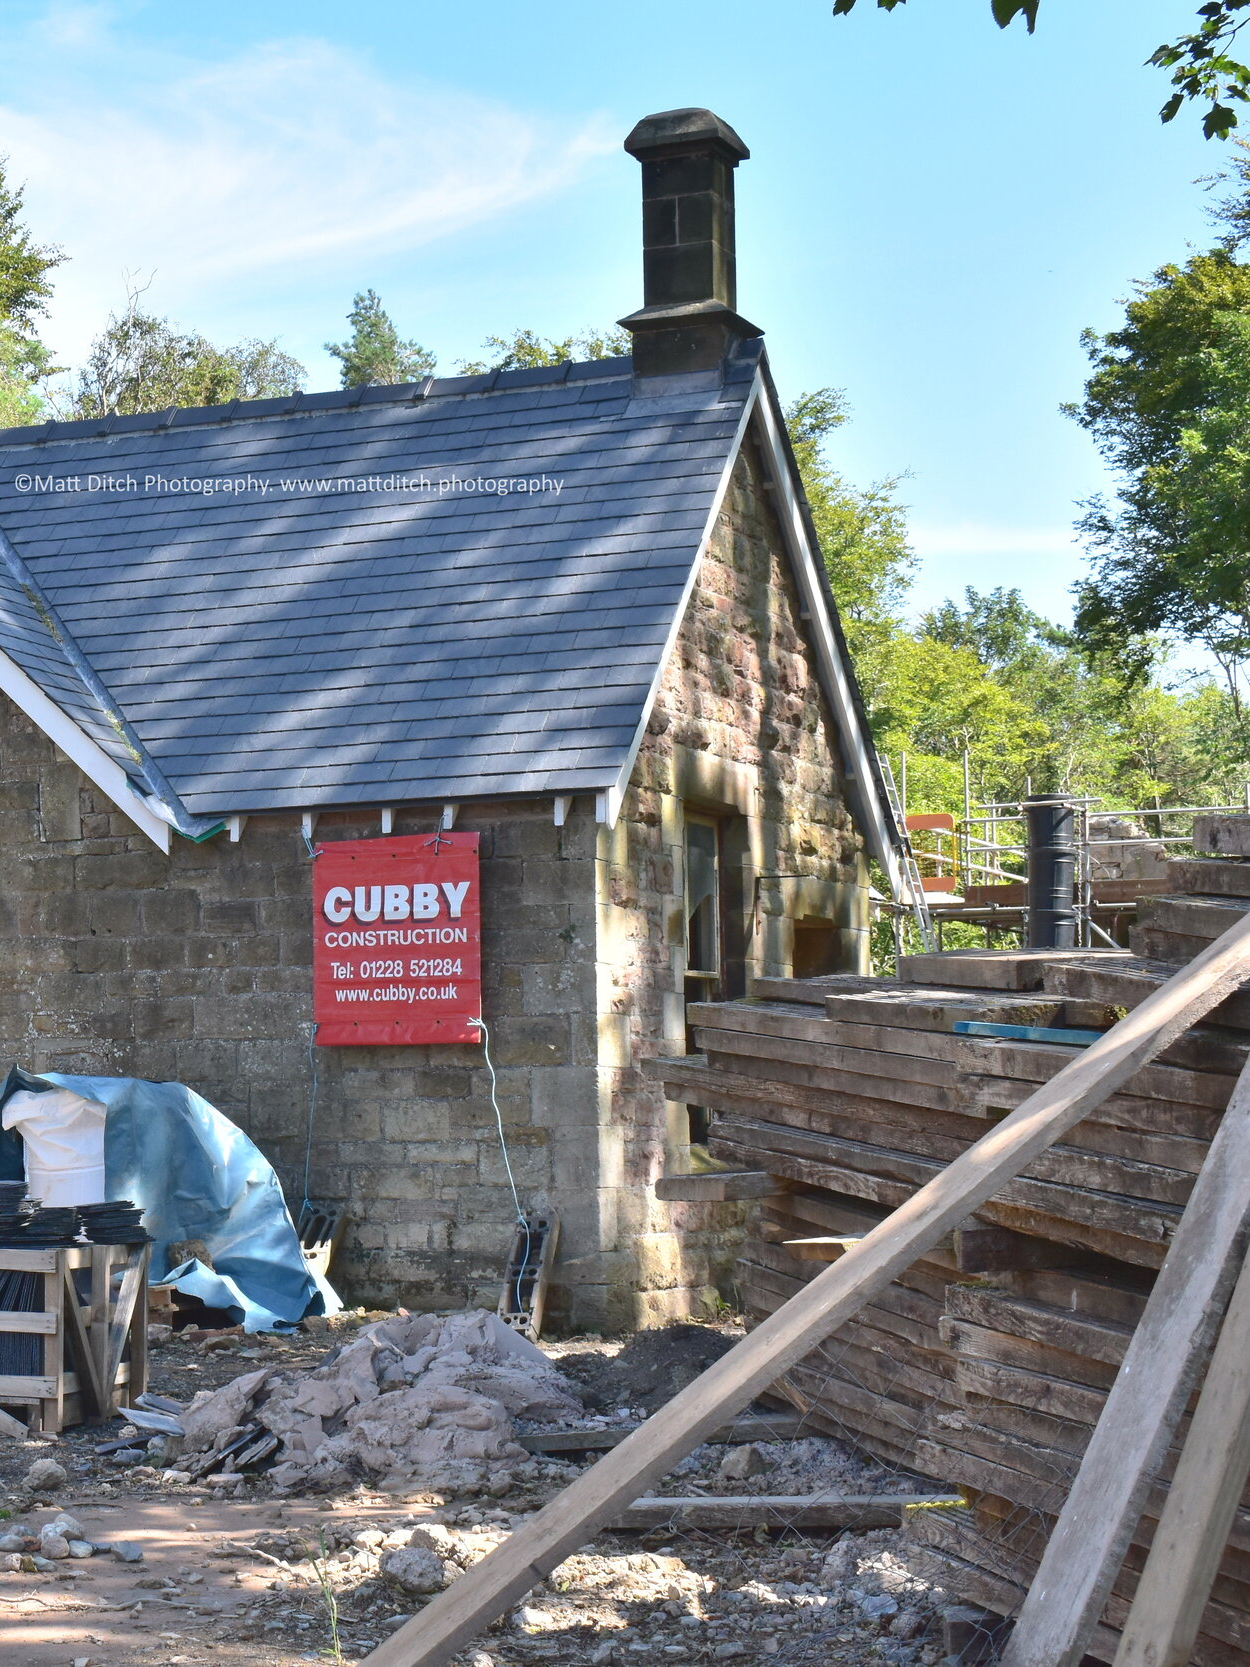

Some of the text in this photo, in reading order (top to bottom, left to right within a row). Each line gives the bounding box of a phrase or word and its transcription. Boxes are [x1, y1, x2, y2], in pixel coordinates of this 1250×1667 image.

[323, 881, 471, 925] CUBBY
[324, 927, 468, 948] CONSTRUCTION
[330, 958, 463, 979] Tel: 01228 521284
[335, 982, 458, 1004] www.cubby.co.uk
